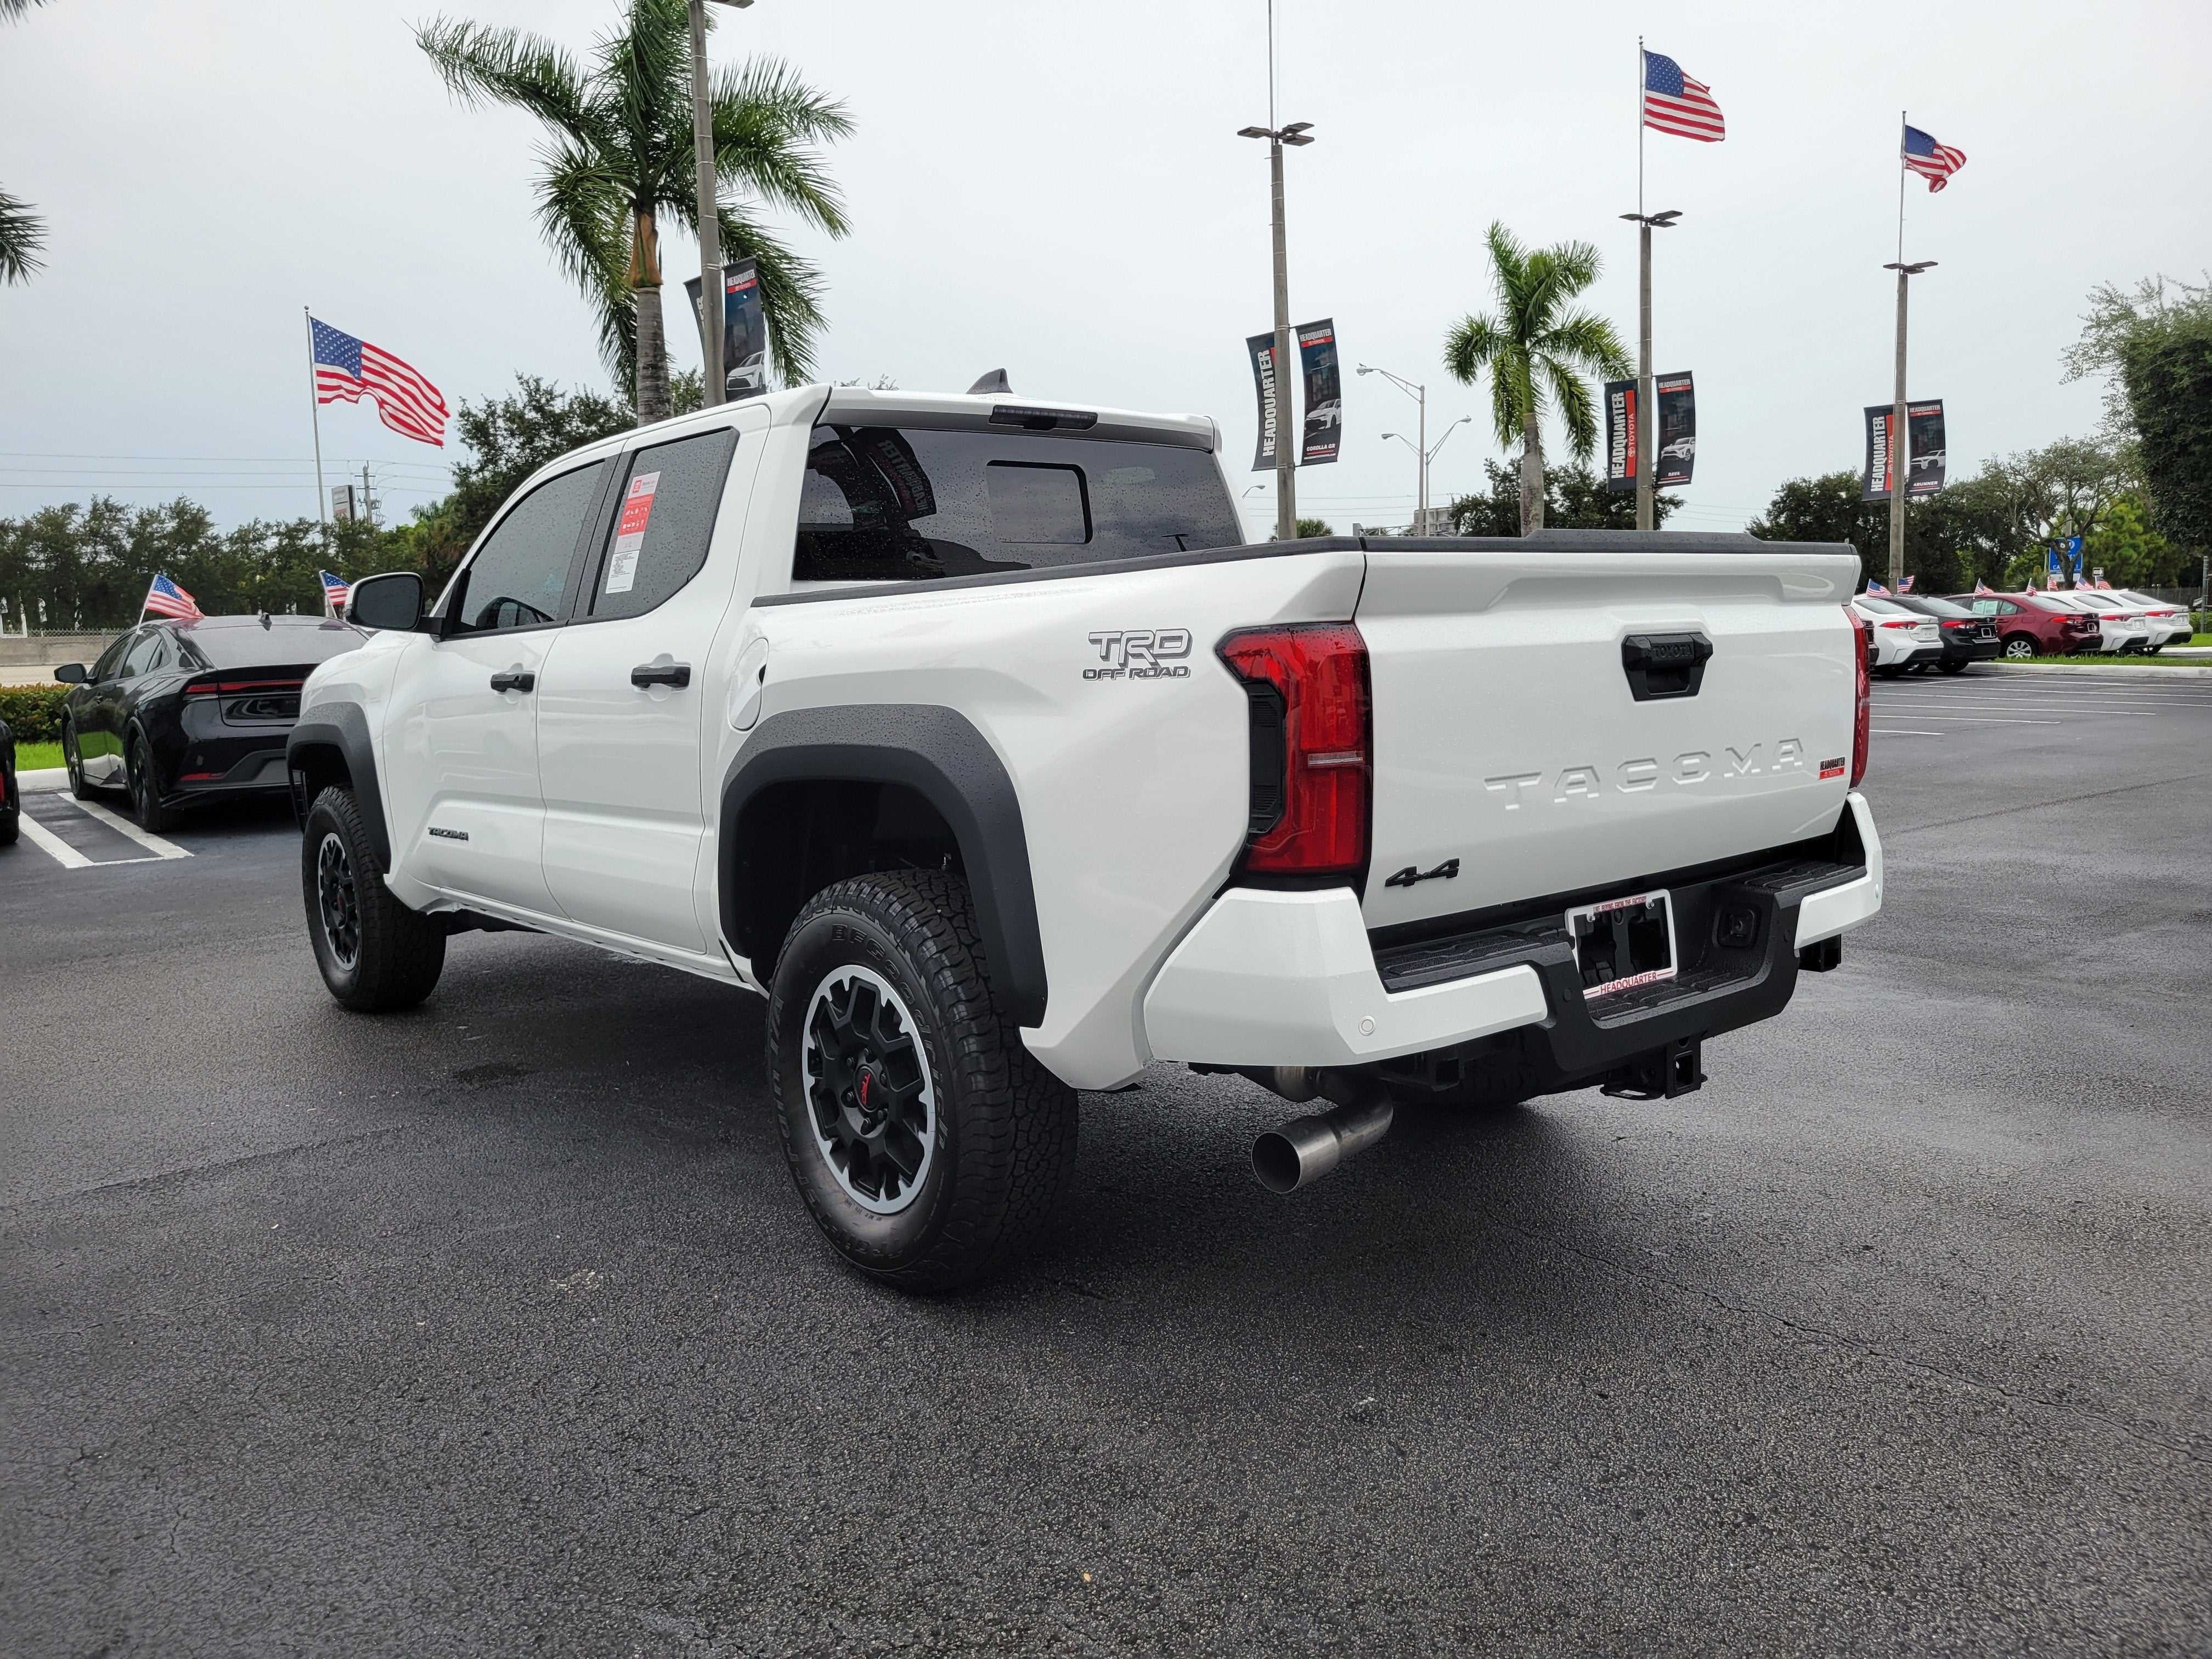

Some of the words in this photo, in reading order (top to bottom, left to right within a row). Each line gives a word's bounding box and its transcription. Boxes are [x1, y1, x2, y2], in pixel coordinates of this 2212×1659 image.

[1300, 329, 1331, 342] HEADQUARTER
[1658, 379, 1690, 388] HEADQUARTER
[1611, 392, 1627, 478] HEADQUARTER
[1871, 416, 1887, 492] HEADQUARTER
[1088, 628, 1193, 668] TRD
[1654, 644, 1692, 658] TOYOTA
[1082, 668, 1126, 680] OFF
[1128, 665, 1190, 680] ROAD
[1484, 737, 1803, 810] TACOMA
[428, 827, 469, 841] TACOMA
[1600, 972, 1657, 994] HEADQUARTER
[861, 1074, 871, 1105] TRD
